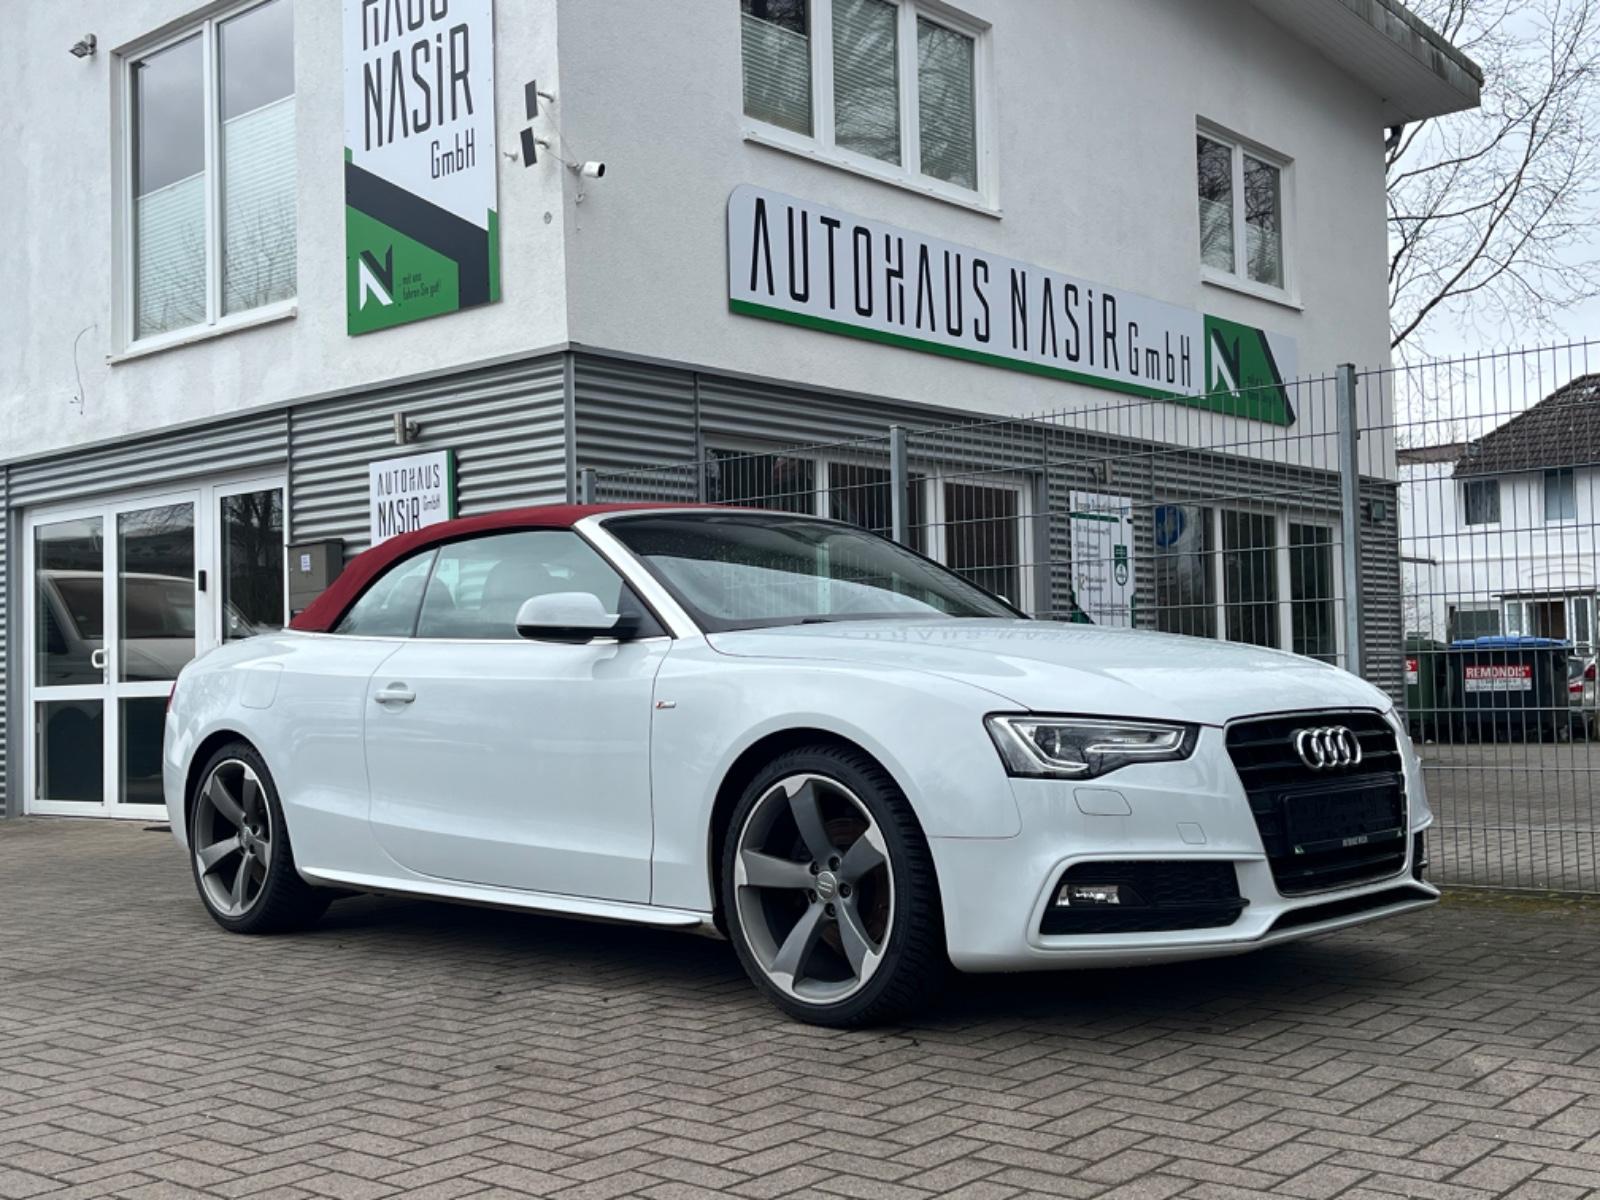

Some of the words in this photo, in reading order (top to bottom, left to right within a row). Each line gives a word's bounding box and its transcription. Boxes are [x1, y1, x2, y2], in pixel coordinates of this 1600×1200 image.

[431, 128, 475, 179] GmbH
[751, 197, 991, 343] AUTOHAUS
[1129, 321, 1191, 388] GmbH
[377, 463, 441, 497] AUTOHAUS
[423, 494, 440, 511] GmbH
